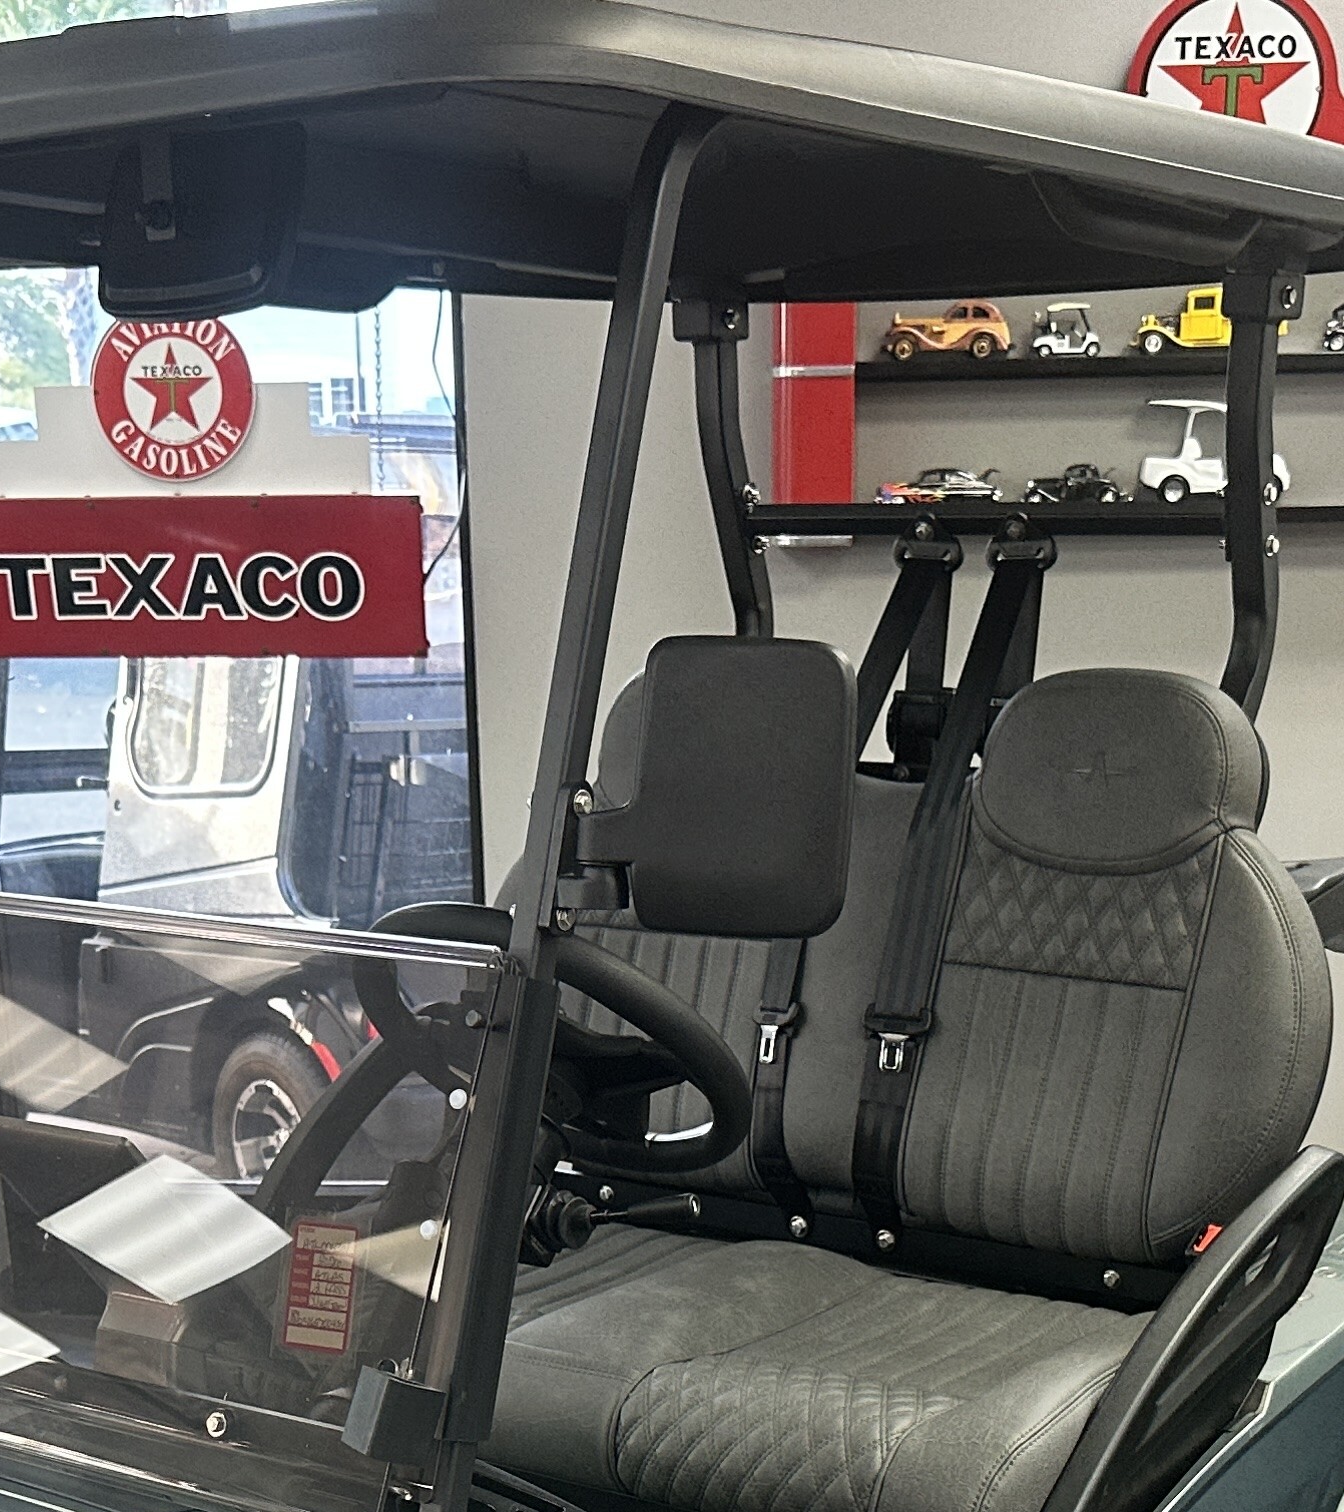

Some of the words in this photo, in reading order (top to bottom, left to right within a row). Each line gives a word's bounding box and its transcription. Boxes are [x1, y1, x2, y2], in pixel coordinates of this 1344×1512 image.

[1174, 34, 1297, 60] TEXACO
[141, 364, 203, 378] TEXACO
[111, 418, 242, 476] GASOLINE
